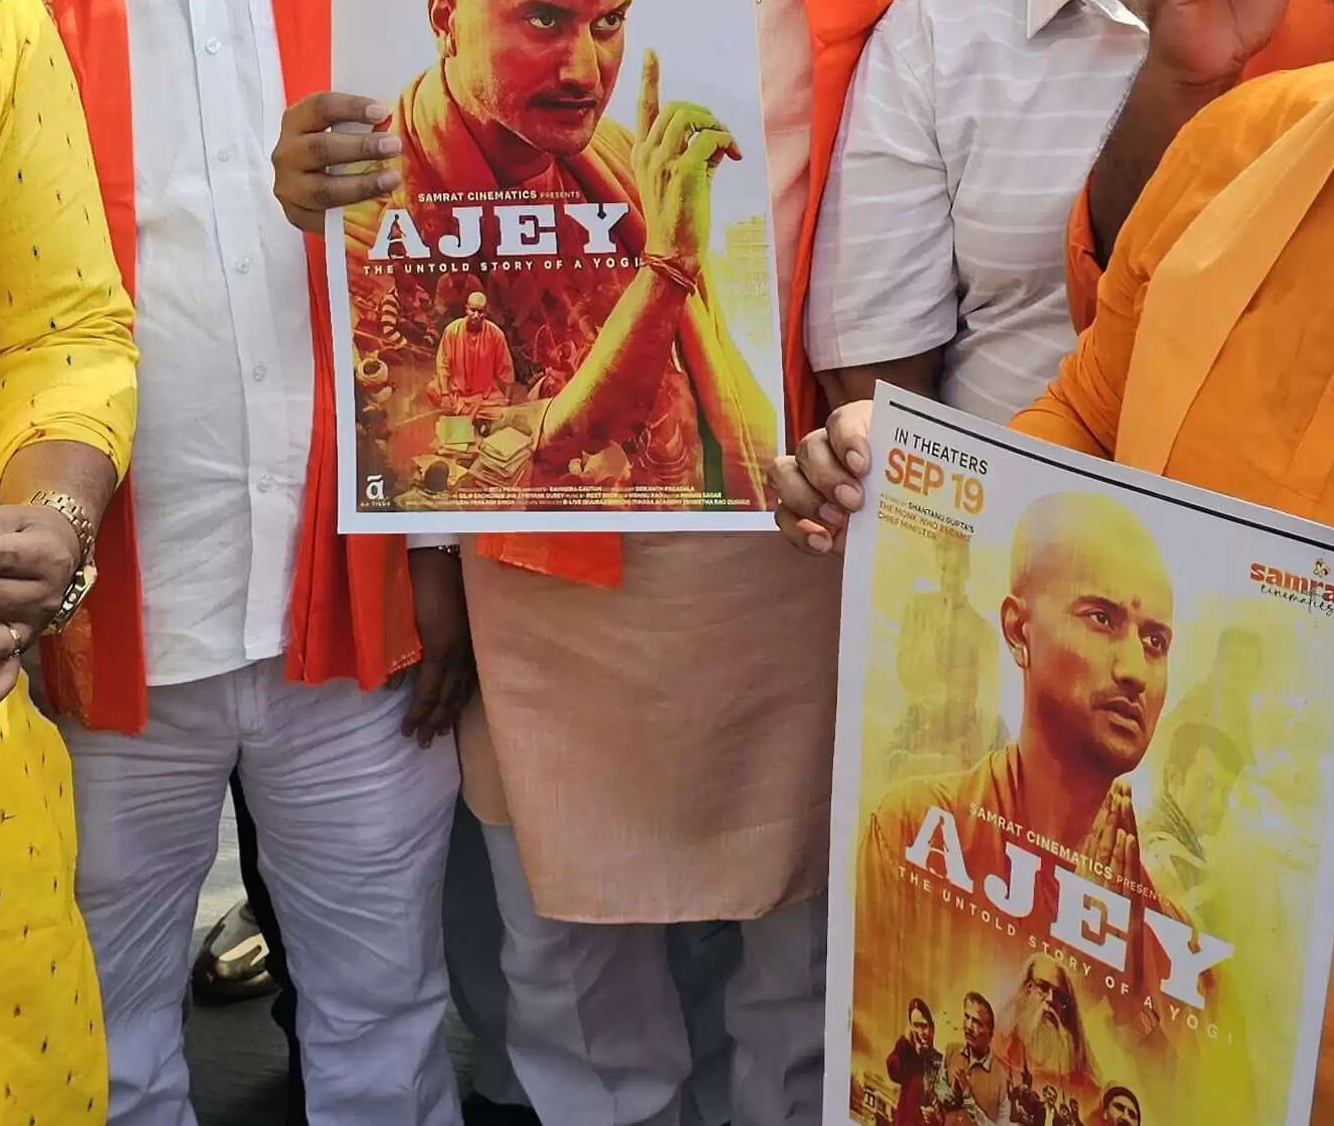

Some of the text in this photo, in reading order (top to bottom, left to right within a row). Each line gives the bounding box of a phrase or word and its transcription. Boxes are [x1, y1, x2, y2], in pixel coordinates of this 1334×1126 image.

[418, 190, 581, 203] SAMRAT CINEMATICS PRESENTS
[368, 203, 629, 260] AJEY
[363, 265, 395, 275] THE
[404, 262, 469, 274] UNTOLD
[480, 261, 533, 272] STORY
[544, 260, 564, 270] OF
[574, 259, 582, 269] A
[885, 448, 985, 515] SEP 19
[894, 427, 988, 475] IN THEATERS
[969, 802, 1171, 907] SAMRAT CINEMATICS PRESENTS
[905, 804, 1234, 1010] AJEY
[899, 866, 1233, 1047] THE UNTOLD STORY OF A YOGI
